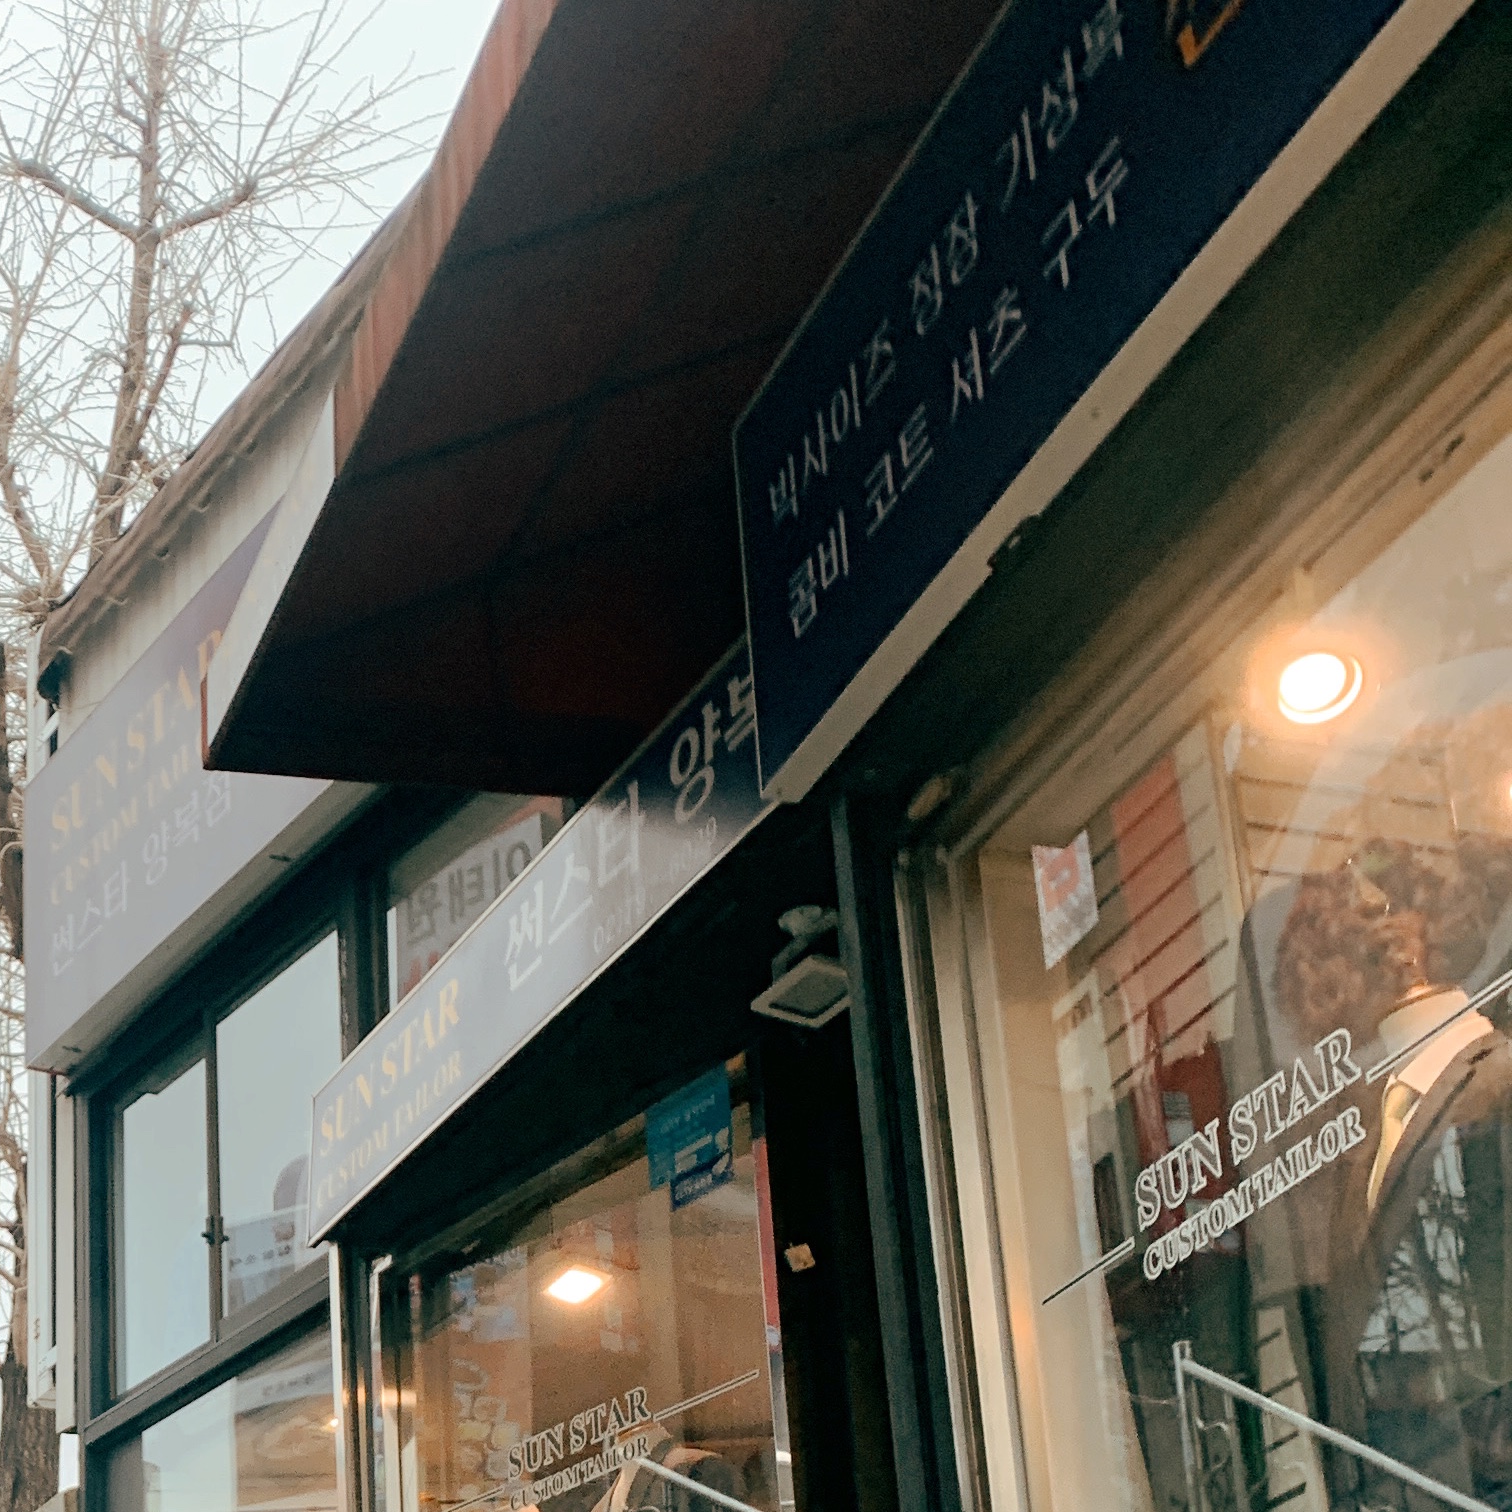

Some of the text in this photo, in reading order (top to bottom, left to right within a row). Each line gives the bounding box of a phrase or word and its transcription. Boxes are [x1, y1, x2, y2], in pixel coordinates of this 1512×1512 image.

[769, 318, 896, 529] 빅사이즈
[909, 189, 978, 336] 정장
[789, 136, 1129, 638] 콤비 코트 셔츠 구두
[51, 737, 119, 851] SUN
[52, 772, 232, 977] 썬스타 양복점
[504, 780, 648, 991] 썬스타
[317, 1050, 463, 1209] CUSTOM TAILOR
[320, 1062, 376, 1157] SUN
[381, 978, 461, 1094] STAR
[1135, 1027, 1362, 1232] SUN STAR
[1142, 1105, 1367, 1281] CUSTOM TAILOR
[508, 1386, 652, 1482] SUN STAR
